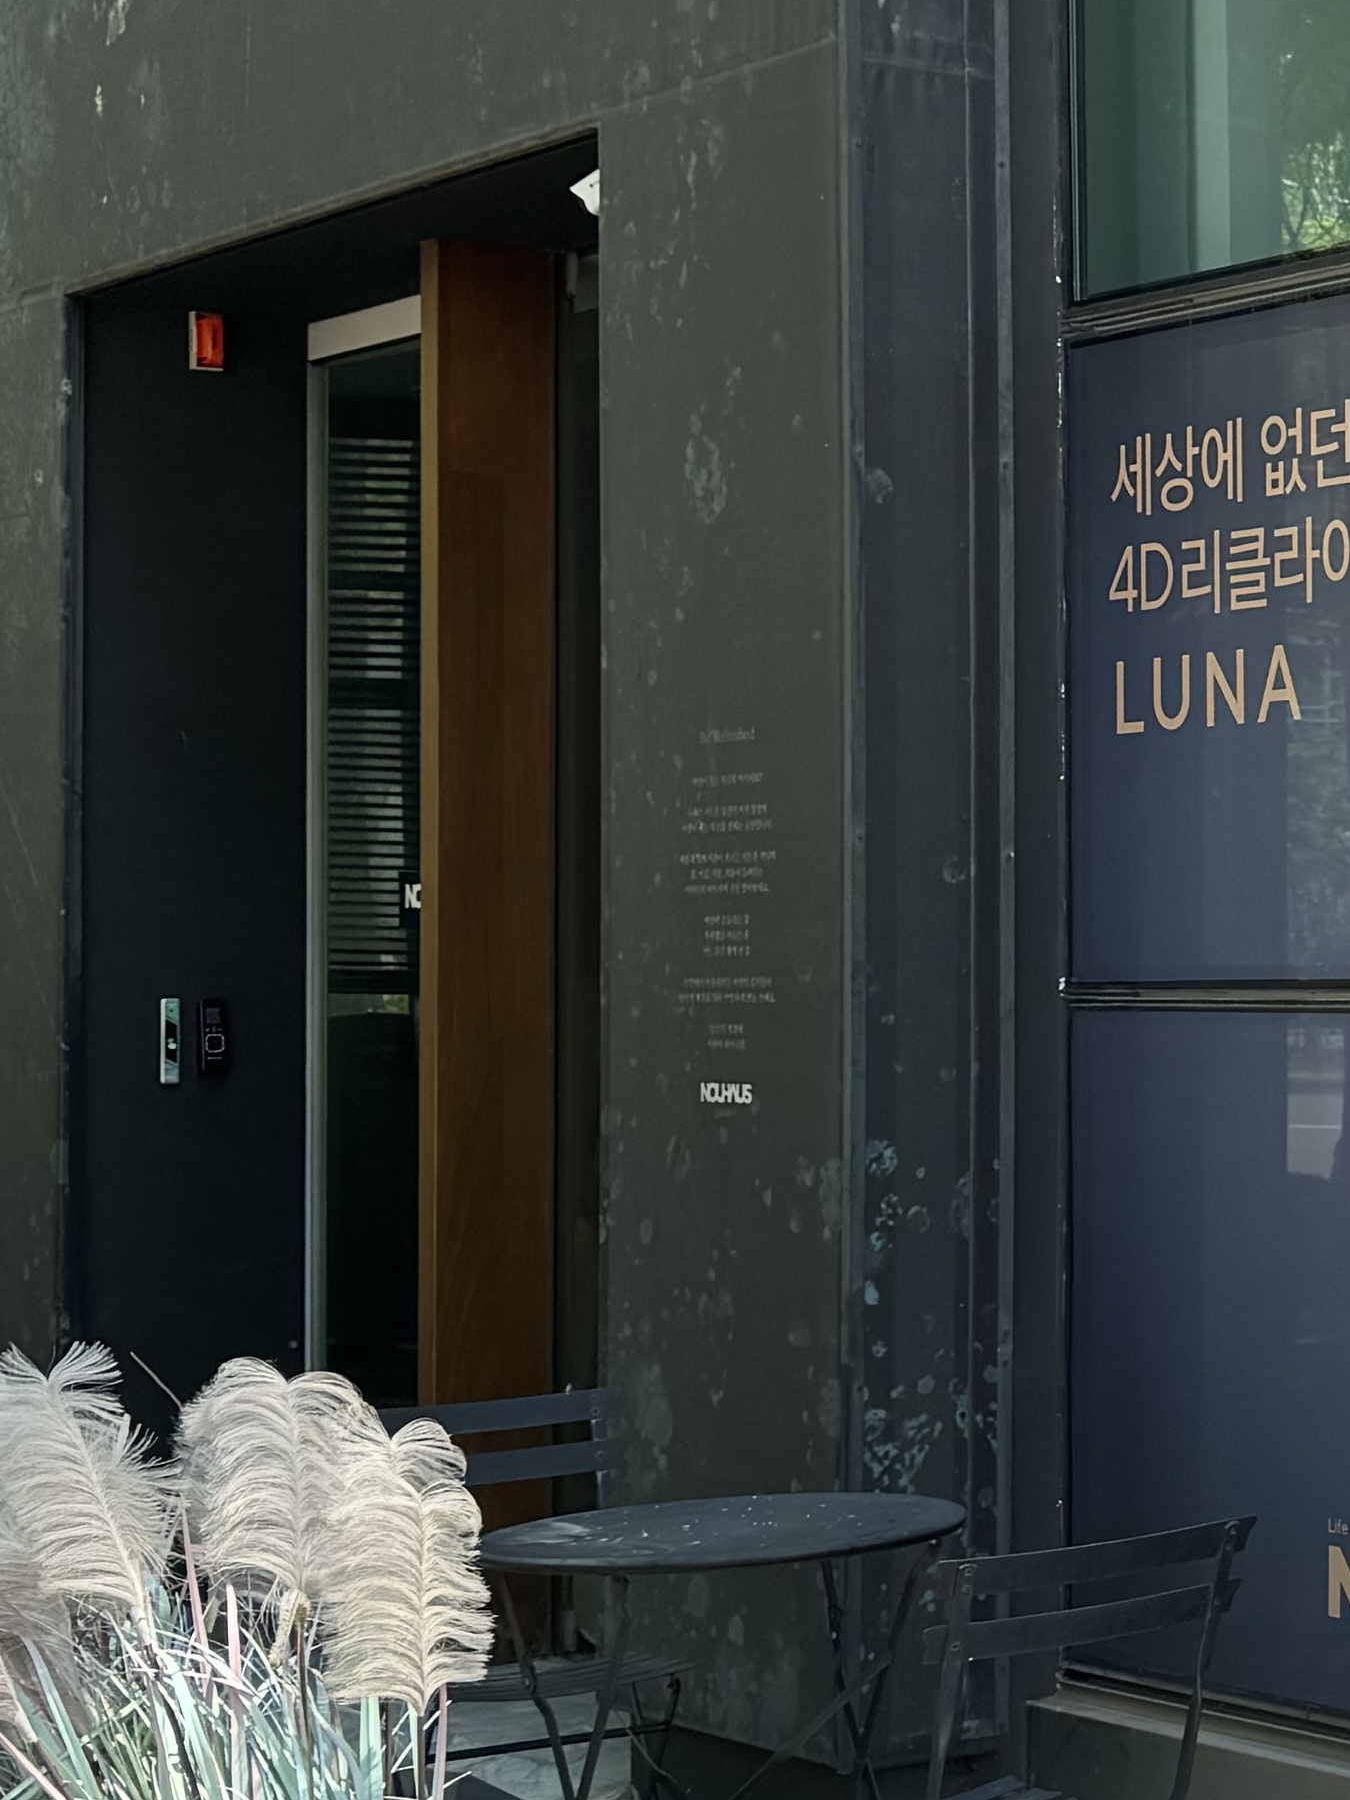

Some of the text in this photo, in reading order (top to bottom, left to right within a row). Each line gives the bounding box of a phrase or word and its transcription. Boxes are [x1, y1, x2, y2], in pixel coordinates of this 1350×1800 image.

[1110, 416, 1243, 516] 세상에
[1115, 644, 1303, 736] LUNA
[700, 1082, 753, 1104] NOUHAUS
[1328, 1517, 1349, 1536] Life
